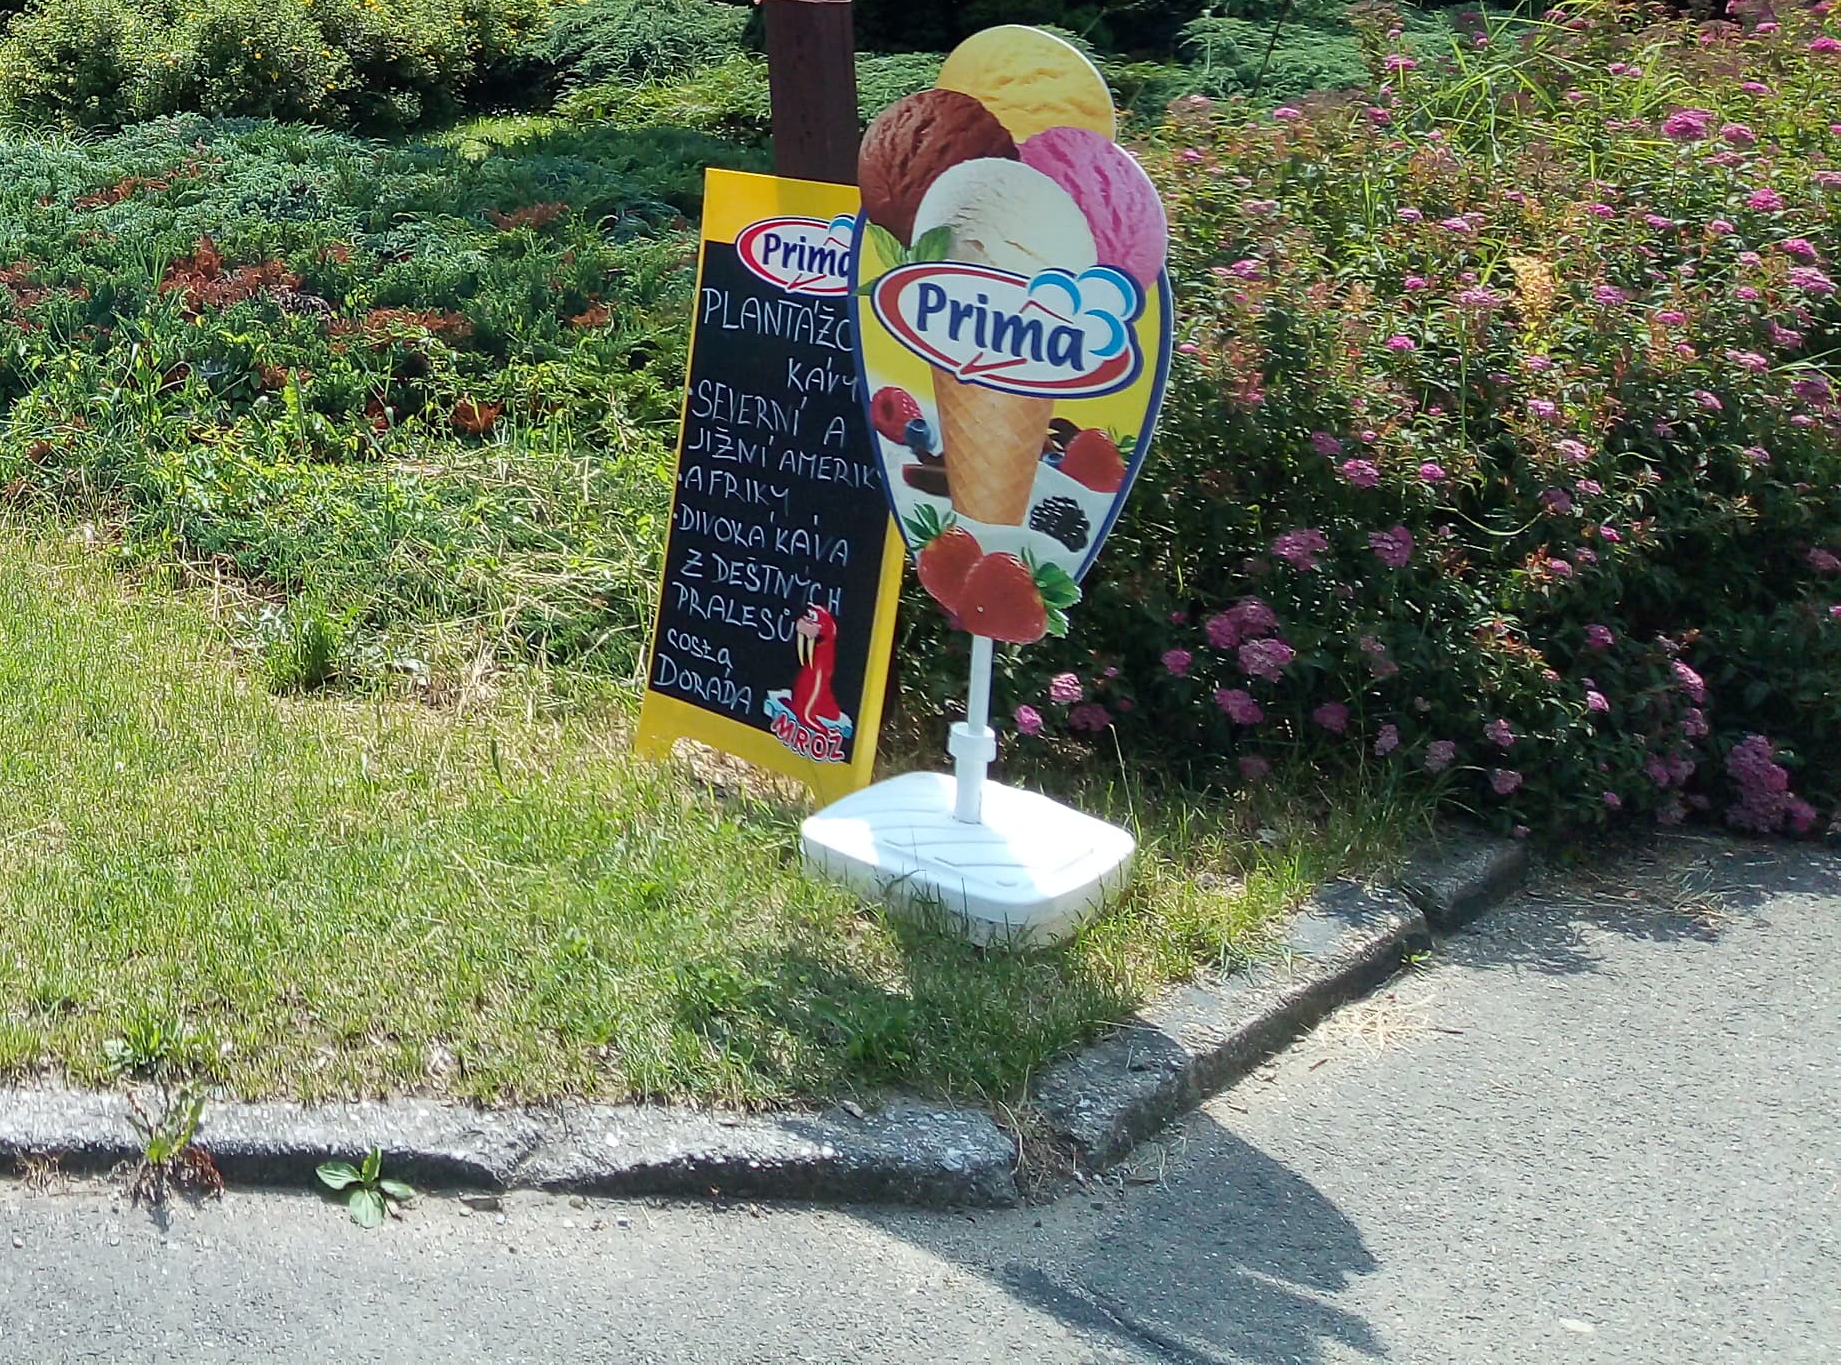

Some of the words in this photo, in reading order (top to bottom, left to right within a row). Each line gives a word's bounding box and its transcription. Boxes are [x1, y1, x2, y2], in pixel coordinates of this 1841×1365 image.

[915, 281, 1086, 372] Prima
[691, 378, 808, 436] SEVERNÍ
[823, 416, 846, 448] A
[687, 426, 774, 468] JIŽNÍ
[778, 449, 882, 490] AMERIK
[679, 548, 703, 578] Z
[671, 581, 795, 642] PRALESŮ
[770, 712, 846, 762] MROŽ
